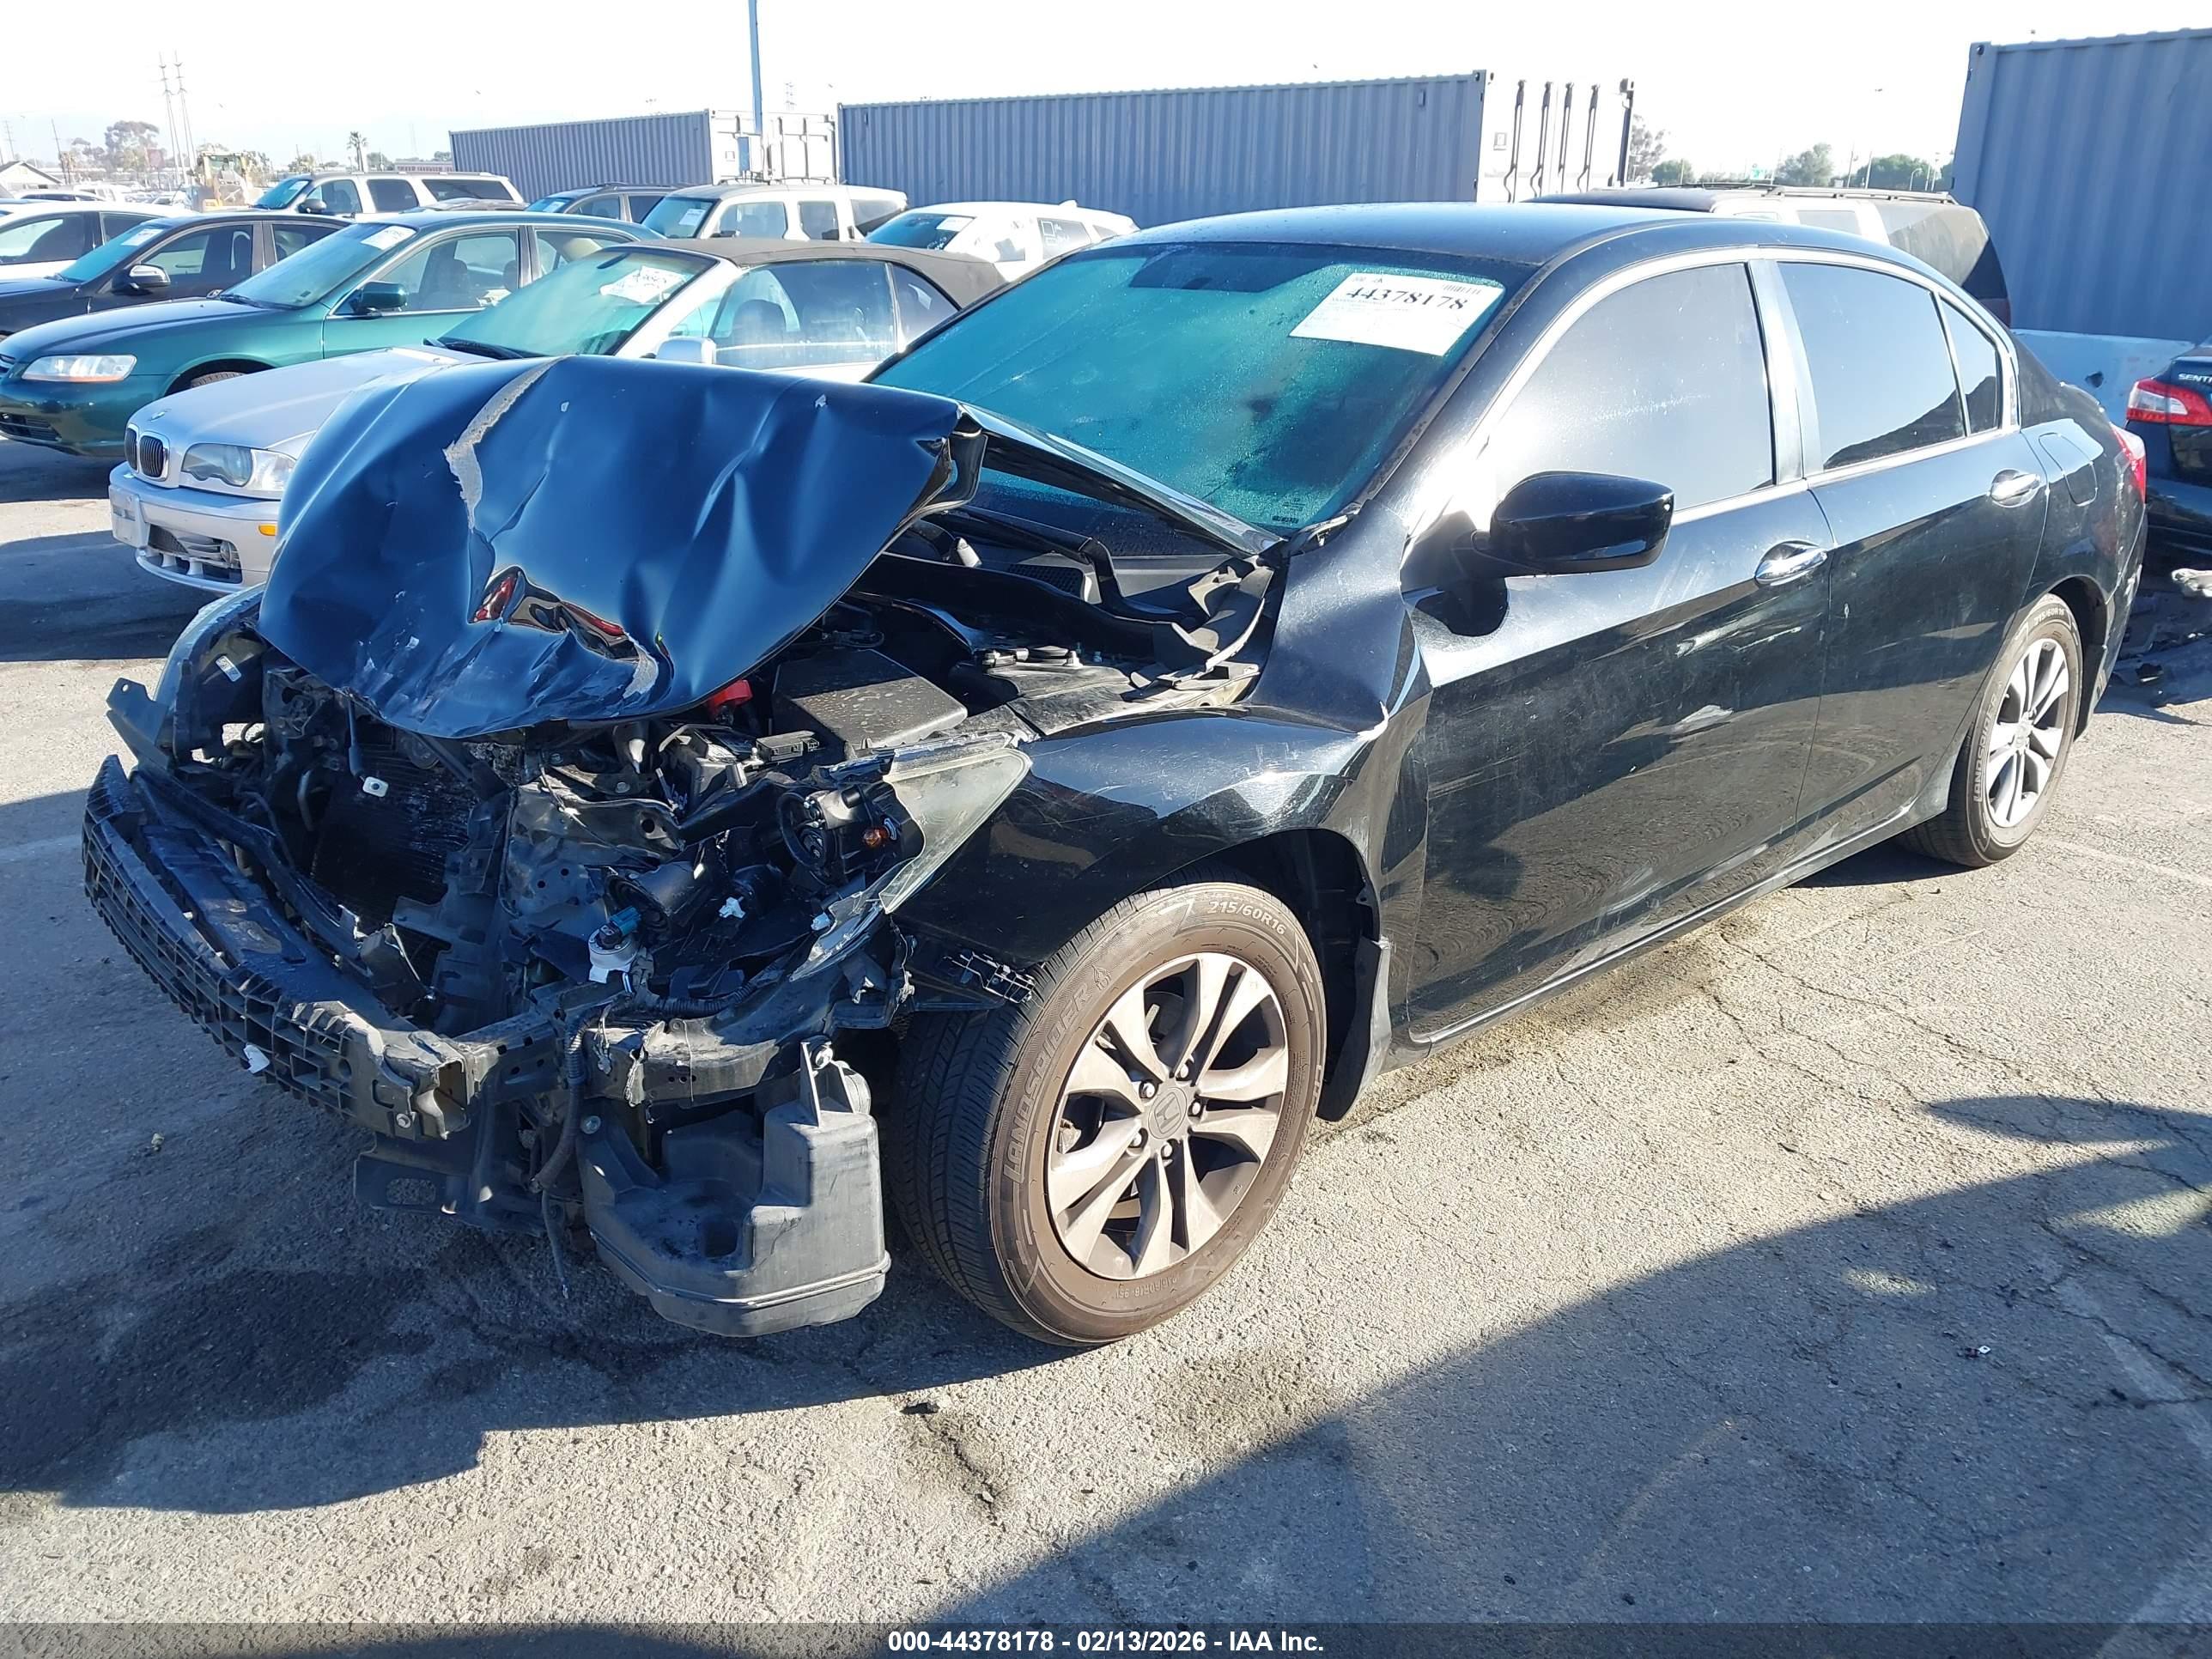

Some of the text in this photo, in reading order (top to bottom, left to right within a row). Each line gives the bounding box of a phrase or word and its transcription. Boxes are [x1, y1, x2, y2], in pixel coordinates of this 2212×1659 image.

[1346, 287, 1468, 309] 44378178
[1207, 901, 1286, 935] 215/60R16
[1003, 983, 1091, 1185] LANDSPIDER
